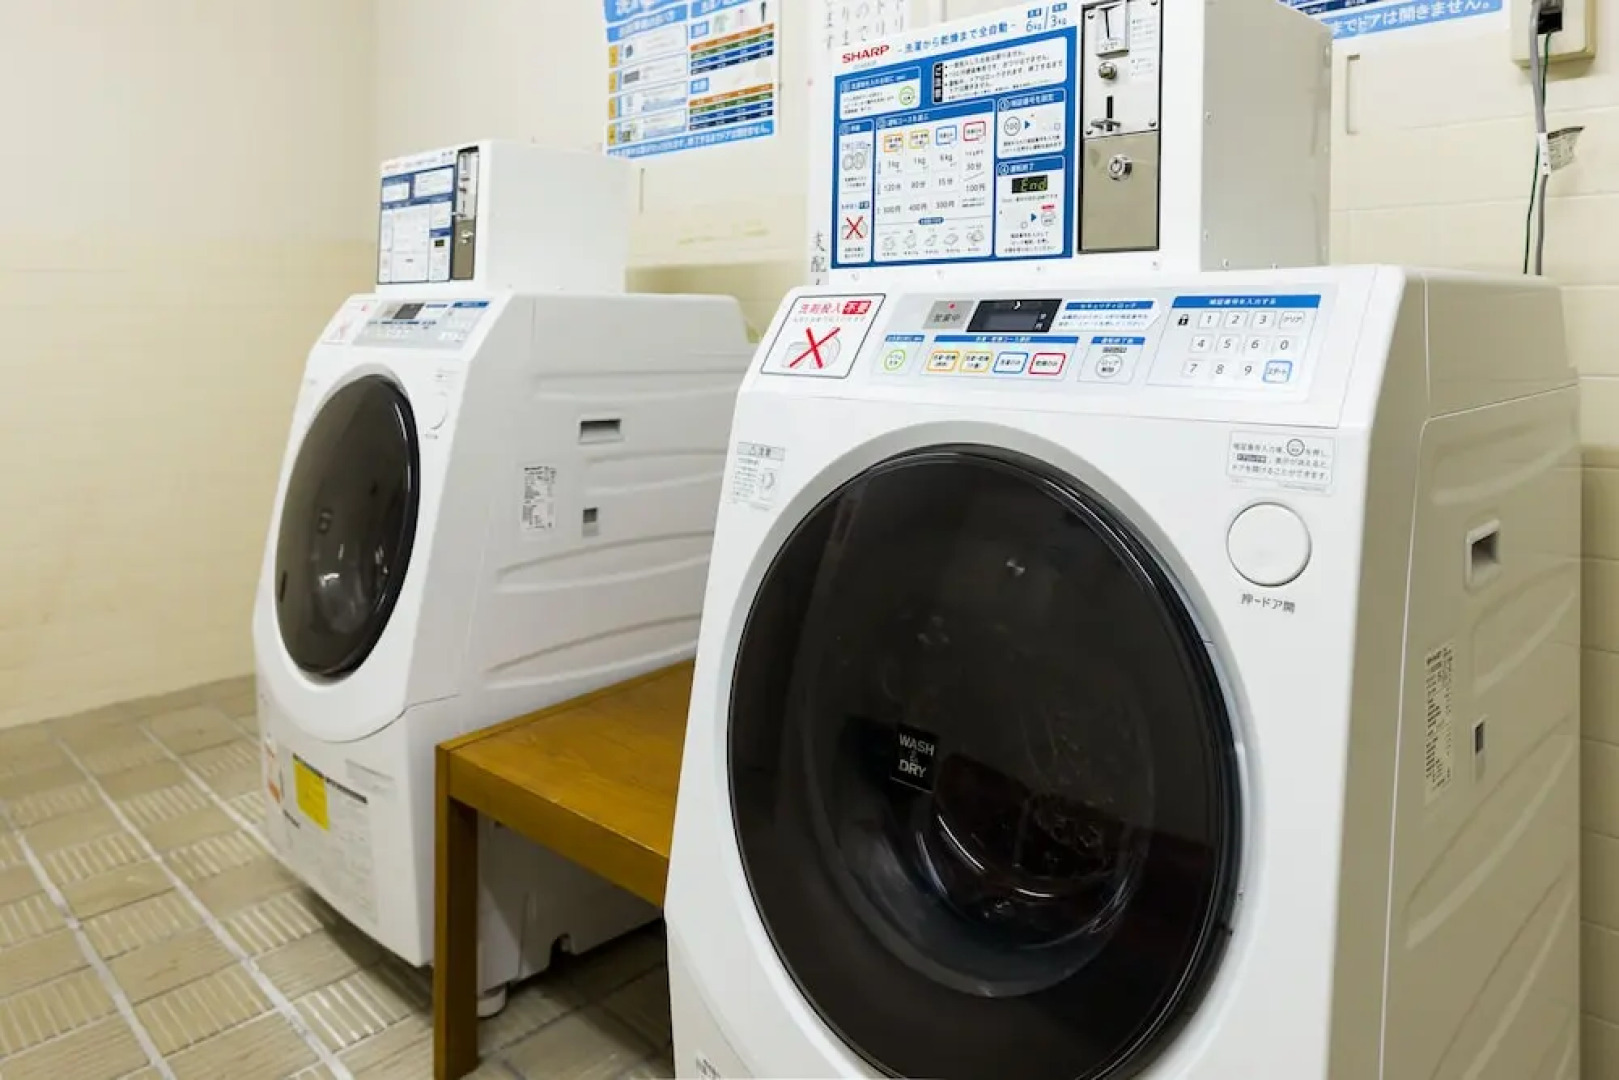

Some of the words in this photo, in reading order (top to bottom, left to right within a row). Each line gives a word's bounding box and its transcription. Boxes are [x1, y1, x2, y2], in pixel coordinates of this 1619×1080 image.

[841, 44, 890, 64] SHARP
[1021, 177, 1048, 192] End
[1206, 315, 1213, 325] 1
[1231, 315, 1240, 325] 2
[1259, 315, 1268, 325] 3
[1197, 339, 1206, 349] 4
[1223, 339, 1232, 349] 5
[1251, 339, 1260, 350] 6
[1280, 339, 1290, 350] 0
[1189, 363, 1199, 374] 7
[1215, 364, 1226, 375] 8
[1244, 365, 1253, 376] 9
[899, 732, 936, 757] WASH
[898, 758, 927, 779] DRY
